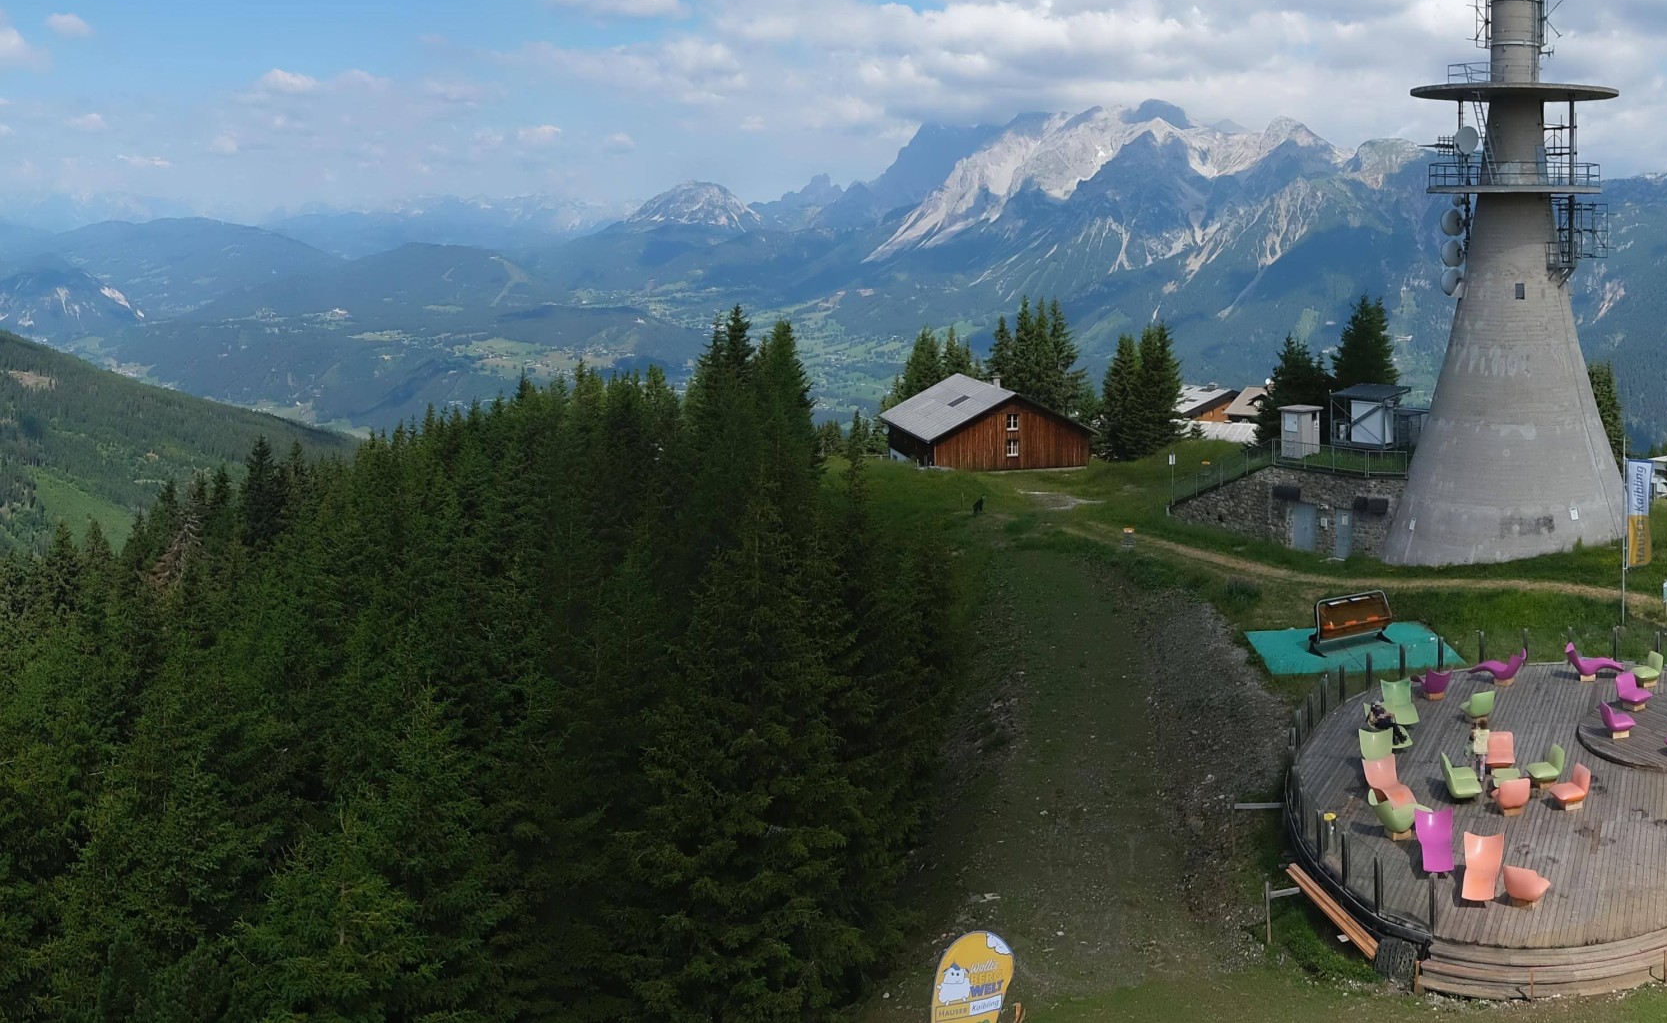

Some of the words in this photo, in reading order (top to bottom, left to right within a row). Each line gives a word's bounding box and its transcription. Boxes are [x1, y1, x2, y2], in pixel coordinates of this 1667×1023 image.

[1633, 465, 1647, 512] Kaibling
[1636, 519, 1645, 563] HAUSER
[970, 969, 1003, 984] BERG
[970, 980, 1004, 997] WELT
[938, 1007, 967, 1018] HAUSER
[971, 1000, 1000, 1012] Kaibling
